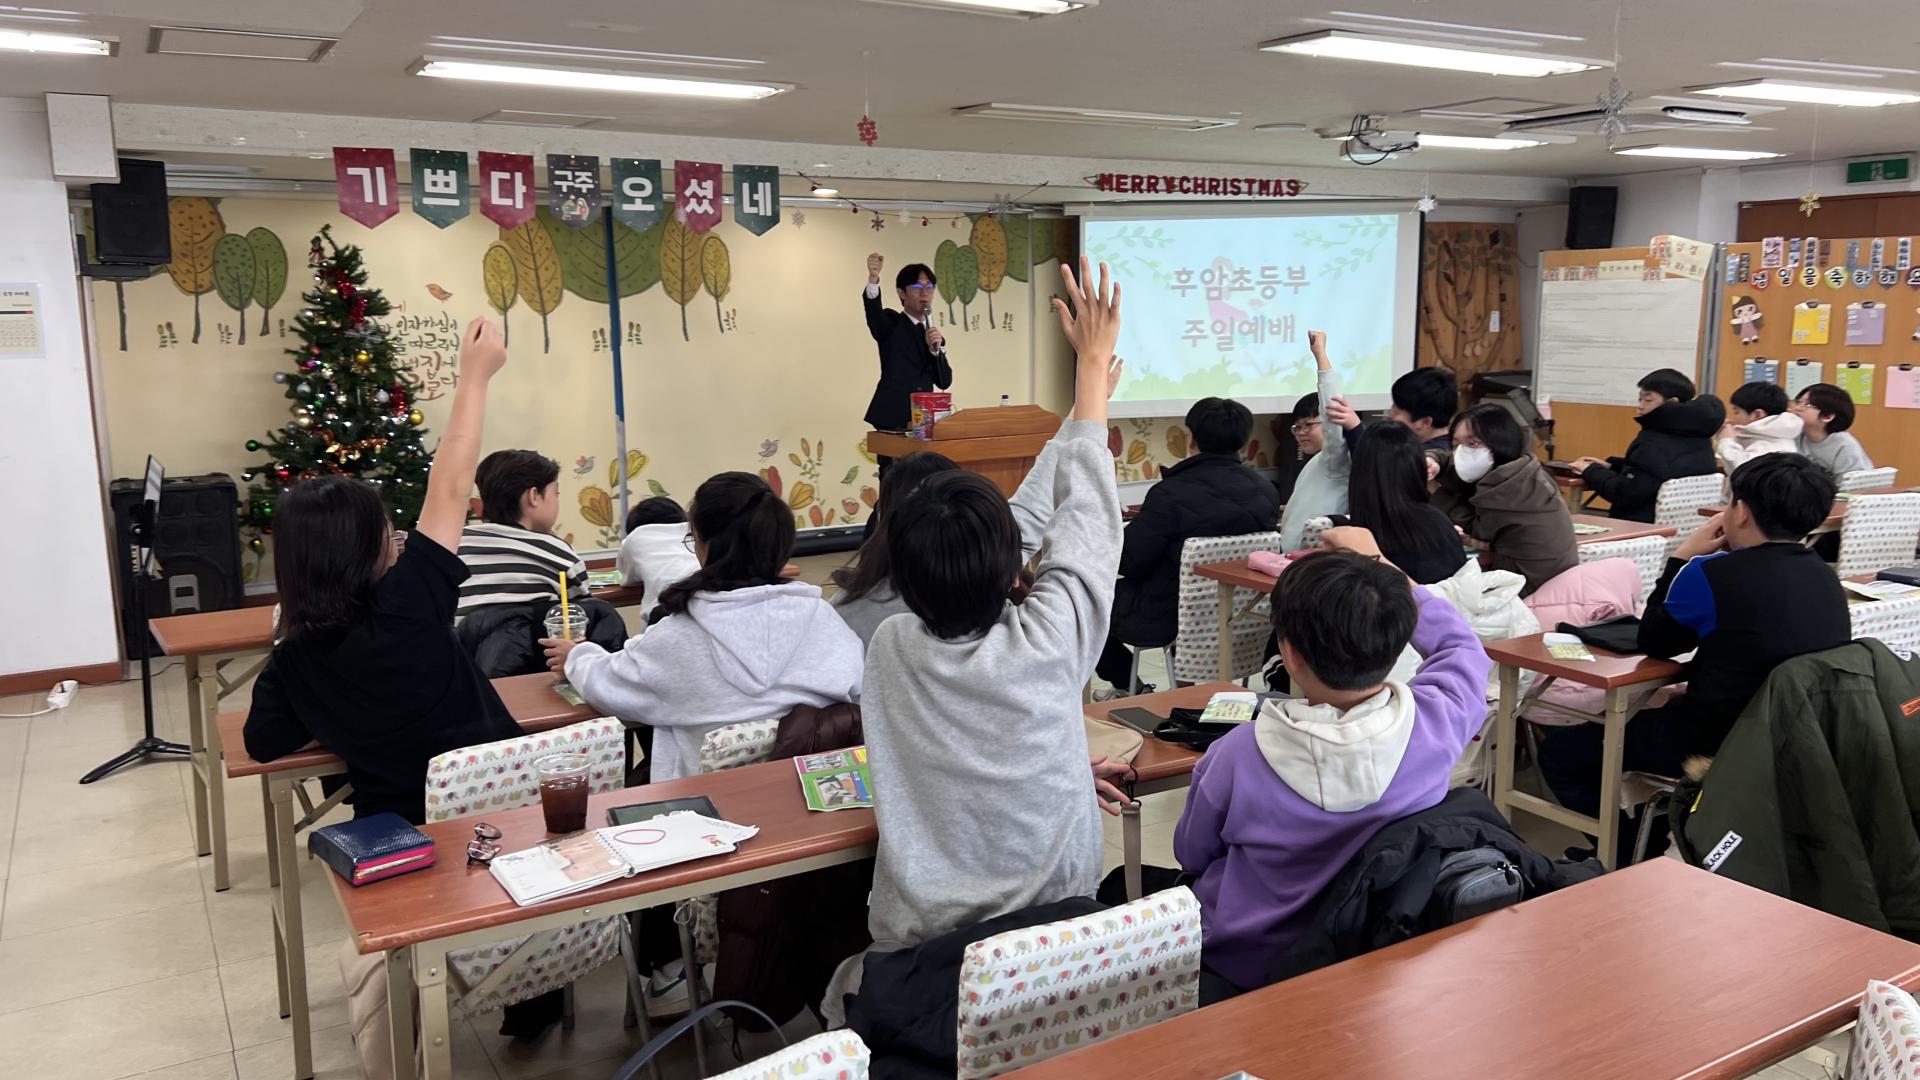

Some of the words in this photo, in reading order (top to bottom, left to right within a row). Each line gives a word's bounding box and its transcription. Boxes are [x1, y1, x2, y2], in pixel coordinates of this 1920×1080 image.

[346, 166, 528, 208] 기쁘다
[553, 170, 595, 194] 구주
[622, 176, 772, 217] 오셨네
[1100, 173, 1177, 195] MERRY
[1178, 176, 1301, 197] CHRISTMAS
[1170, 265, 1311, 300] 후암초등부
[1181, 314, 1297, 351] 주일예배
[1721, 834, 1738, 852] HOLE
